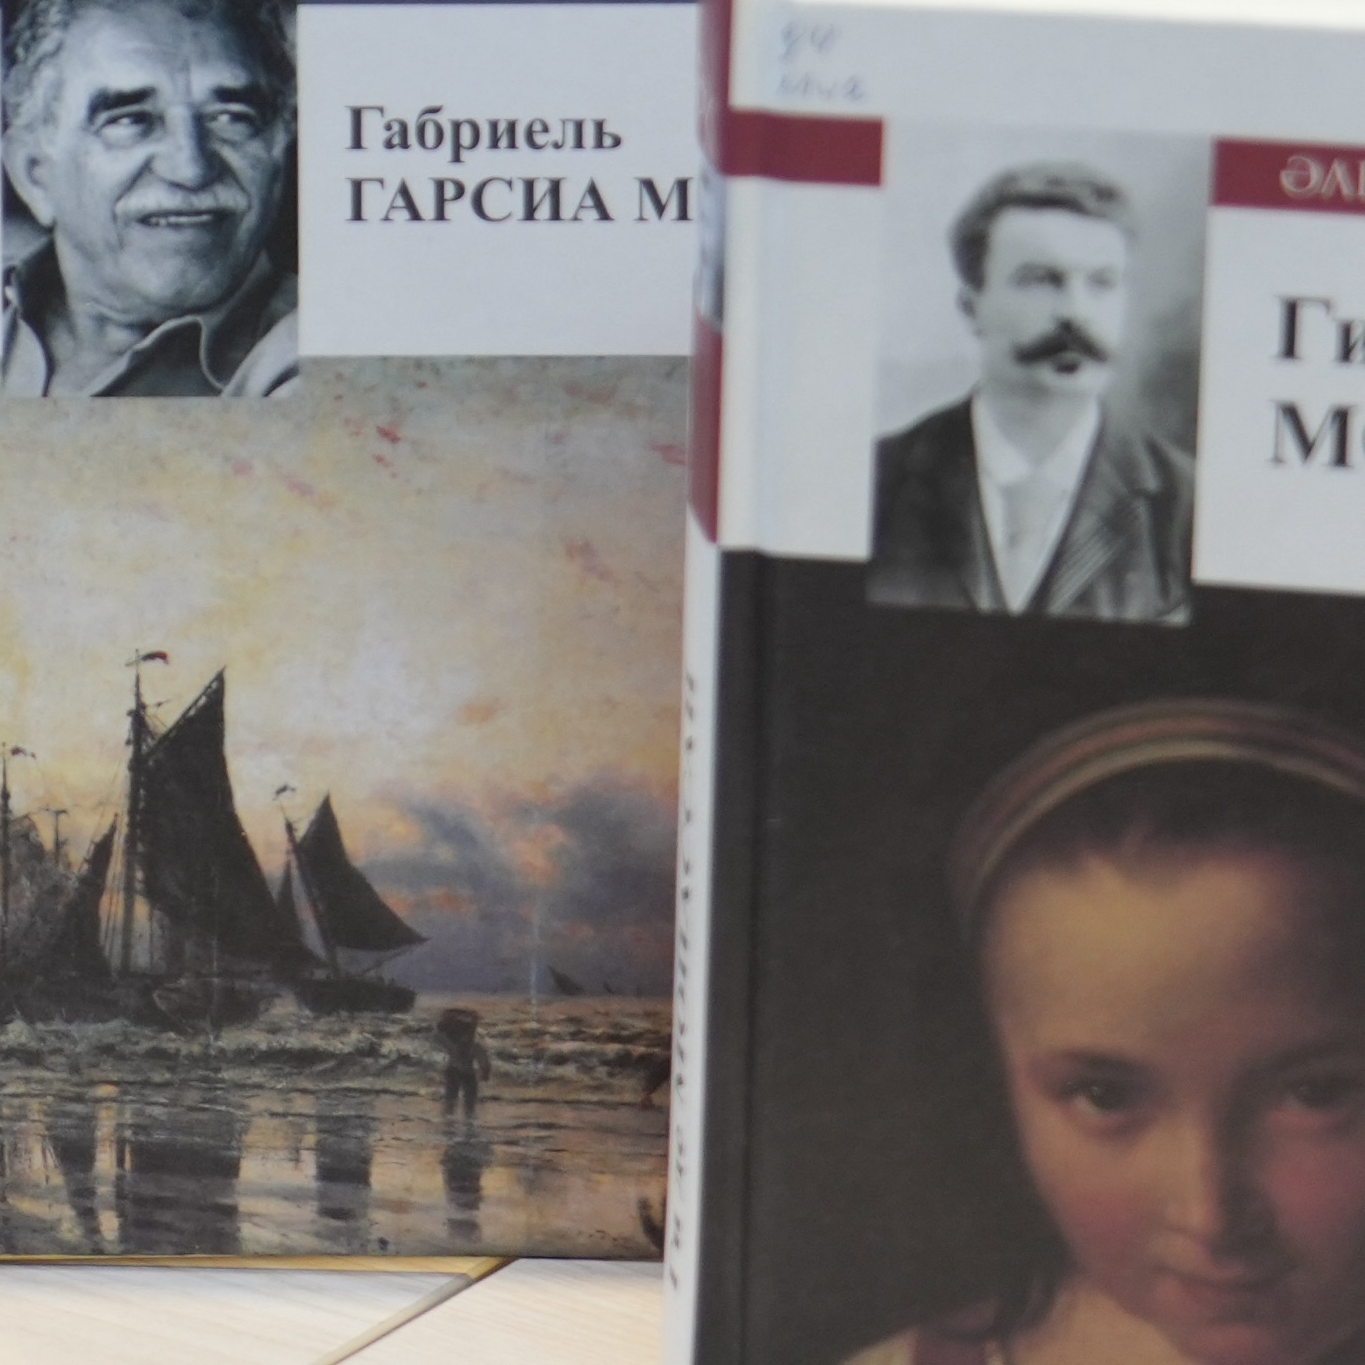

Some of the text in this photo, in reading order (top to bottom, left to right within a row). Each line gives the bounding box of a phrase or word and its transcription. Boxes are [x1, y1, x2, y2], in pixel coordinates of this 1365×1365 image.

[344, 104, 623, 165] Габриель
[345, 175, 695, 223] ГАРСИА М
